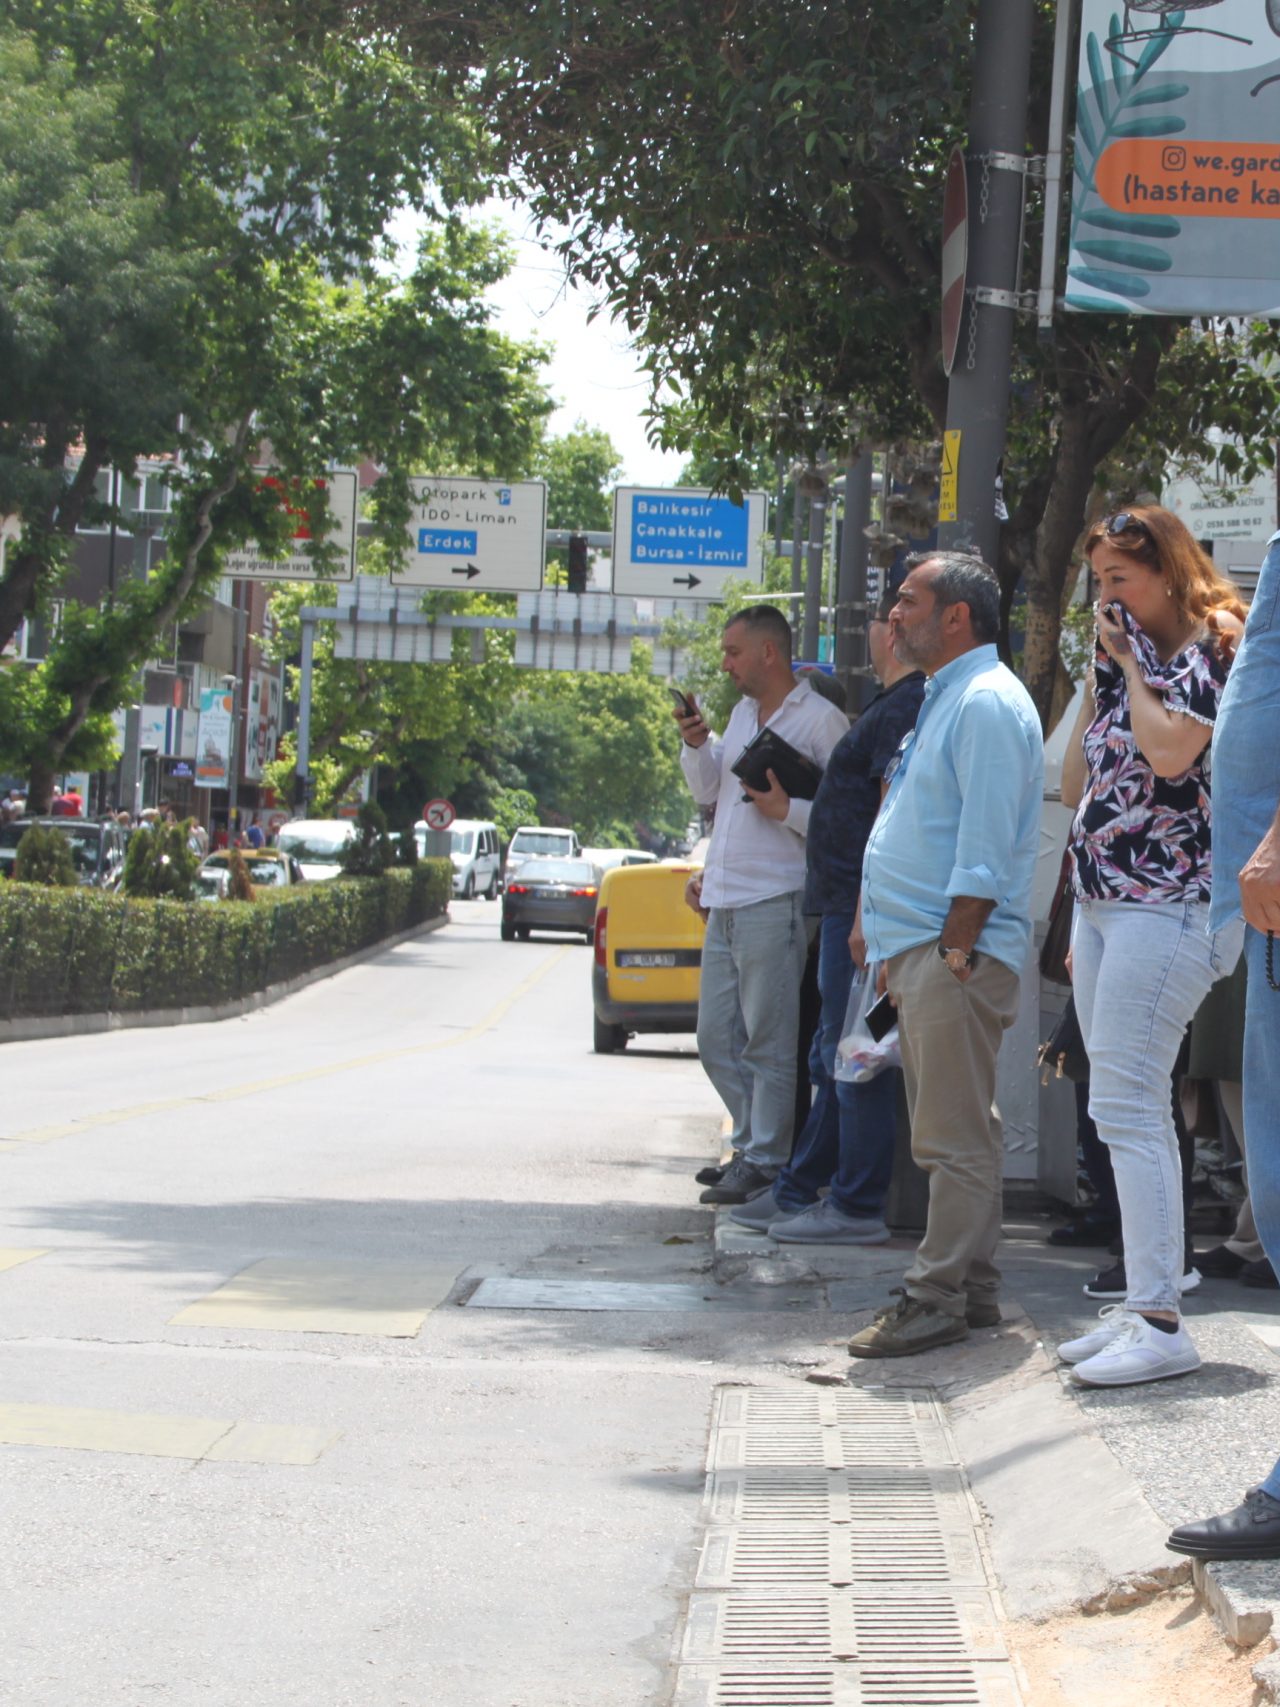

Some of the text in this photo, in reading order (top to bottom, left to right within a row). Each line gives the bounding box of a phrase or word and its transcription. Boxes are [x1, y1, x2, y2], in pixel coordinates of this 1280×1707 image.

[1123, 173, 1240, 204] (hastane
[421, 486, 487, 501] Otopark
[637, 501, 713, 517] Balıkesir
[465, 510, 517, 525] Liman
[636, 523, 723, 539] Çanakkale
[423, 534, 472, 549] Erdek
[636, 544, 684, 559] Bursa
[698, 543, 744, 562] İzmir
